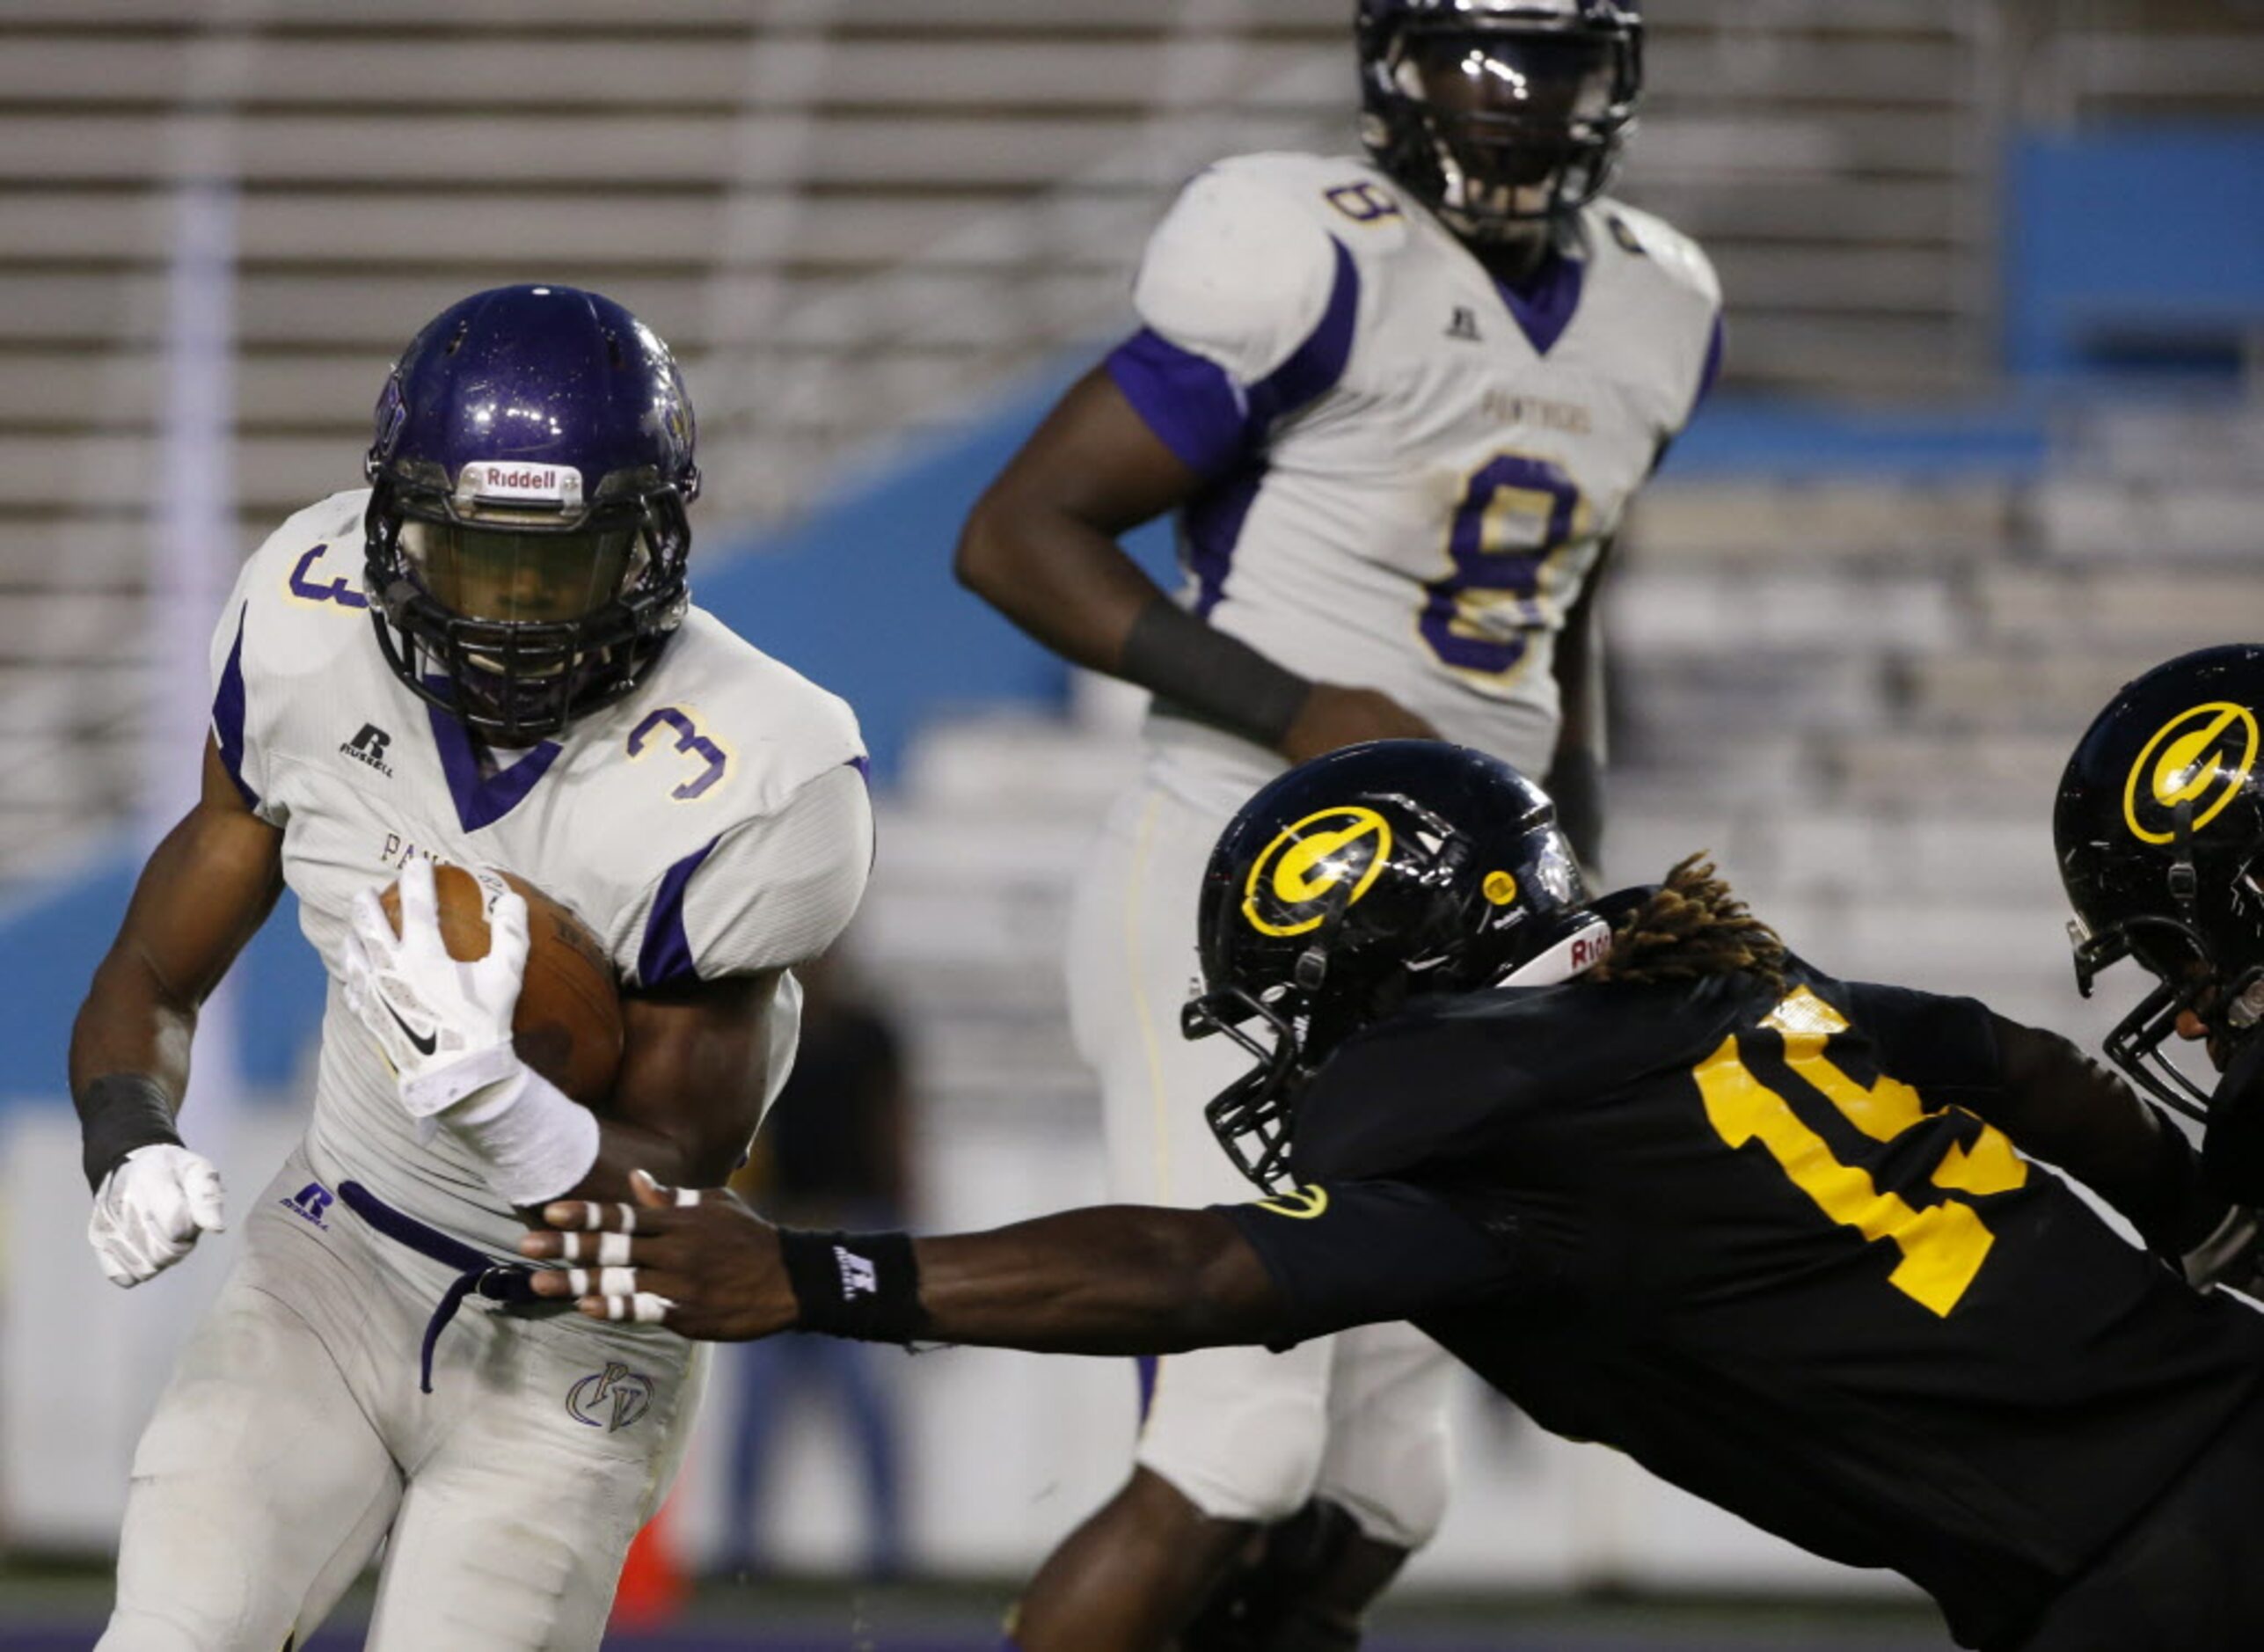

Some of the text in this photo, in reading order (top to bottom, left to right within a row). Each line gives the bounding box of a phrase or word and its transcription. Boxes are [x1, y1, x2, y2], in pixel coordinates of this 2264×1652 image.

[488, 468, 555, 489] Riddell
[1417, 450, 1588, 679] 8
[625, 705, 734, 801] 3
